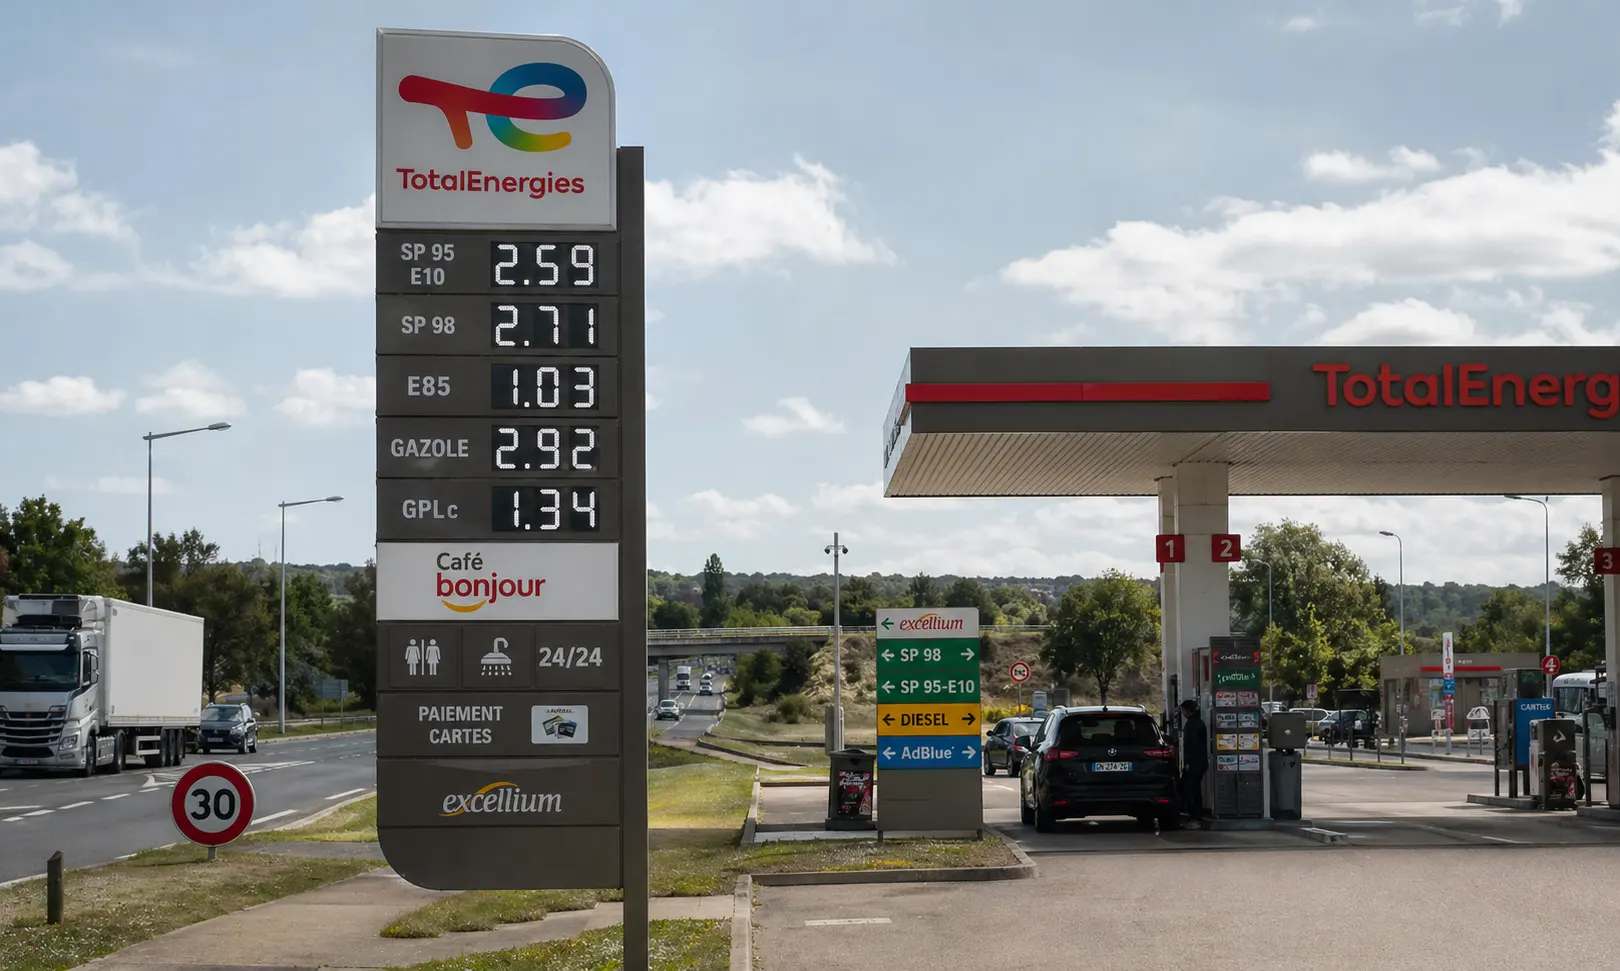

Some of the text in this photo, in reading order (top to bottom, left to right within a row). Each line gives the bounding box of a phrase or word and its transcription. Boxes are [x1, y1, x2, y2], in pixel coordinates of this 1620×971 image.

[396, 168, 585, 199] TotalEnergies
[401, 243, 455, 261] SP 95
[496, 244, 594, 286] 2.59
[411, 268, 445, 285] E10
[402, 316, 456, 334] SP 98
[496, 305, 595, 346] 2.71
[408, 376, 451, 396] E85
[513, 367, 595, 408] 1.03
[1312, 363, 1620, 419] TotalEnerg
[391, 438, 469, 458] GAZOLE
[496, 428, 595, 469] 2.92
[403, 500, 458, 519] GPLc
[514, 489, 596, 530] 1.34
[1164, 540, 1175, 558] 1
[1220, 540, 1233, 558] 2
[437, 551, 483, 570] Café
[1602, 552, 1613, 570] 3
[437, 572, 545, 603] bonjour
[900, 615, 963, 631] excellium
[539, 646, 603, 669] 24/24
[901, 648, 942, 661] SP 98
[1545, 657, 1556, 672] 4
[901, 680, 974, 693] SP 95-E10
[419, 705, 503, 721] PAIEMENT
[901, 713, 949, 726] DIESEL
[430, 728, 491, 744] CARTES
[902, 746, 952, 760] AdBlue
[190, 788, 236, 821] 30
[443, 786, 561, 814] excellium
